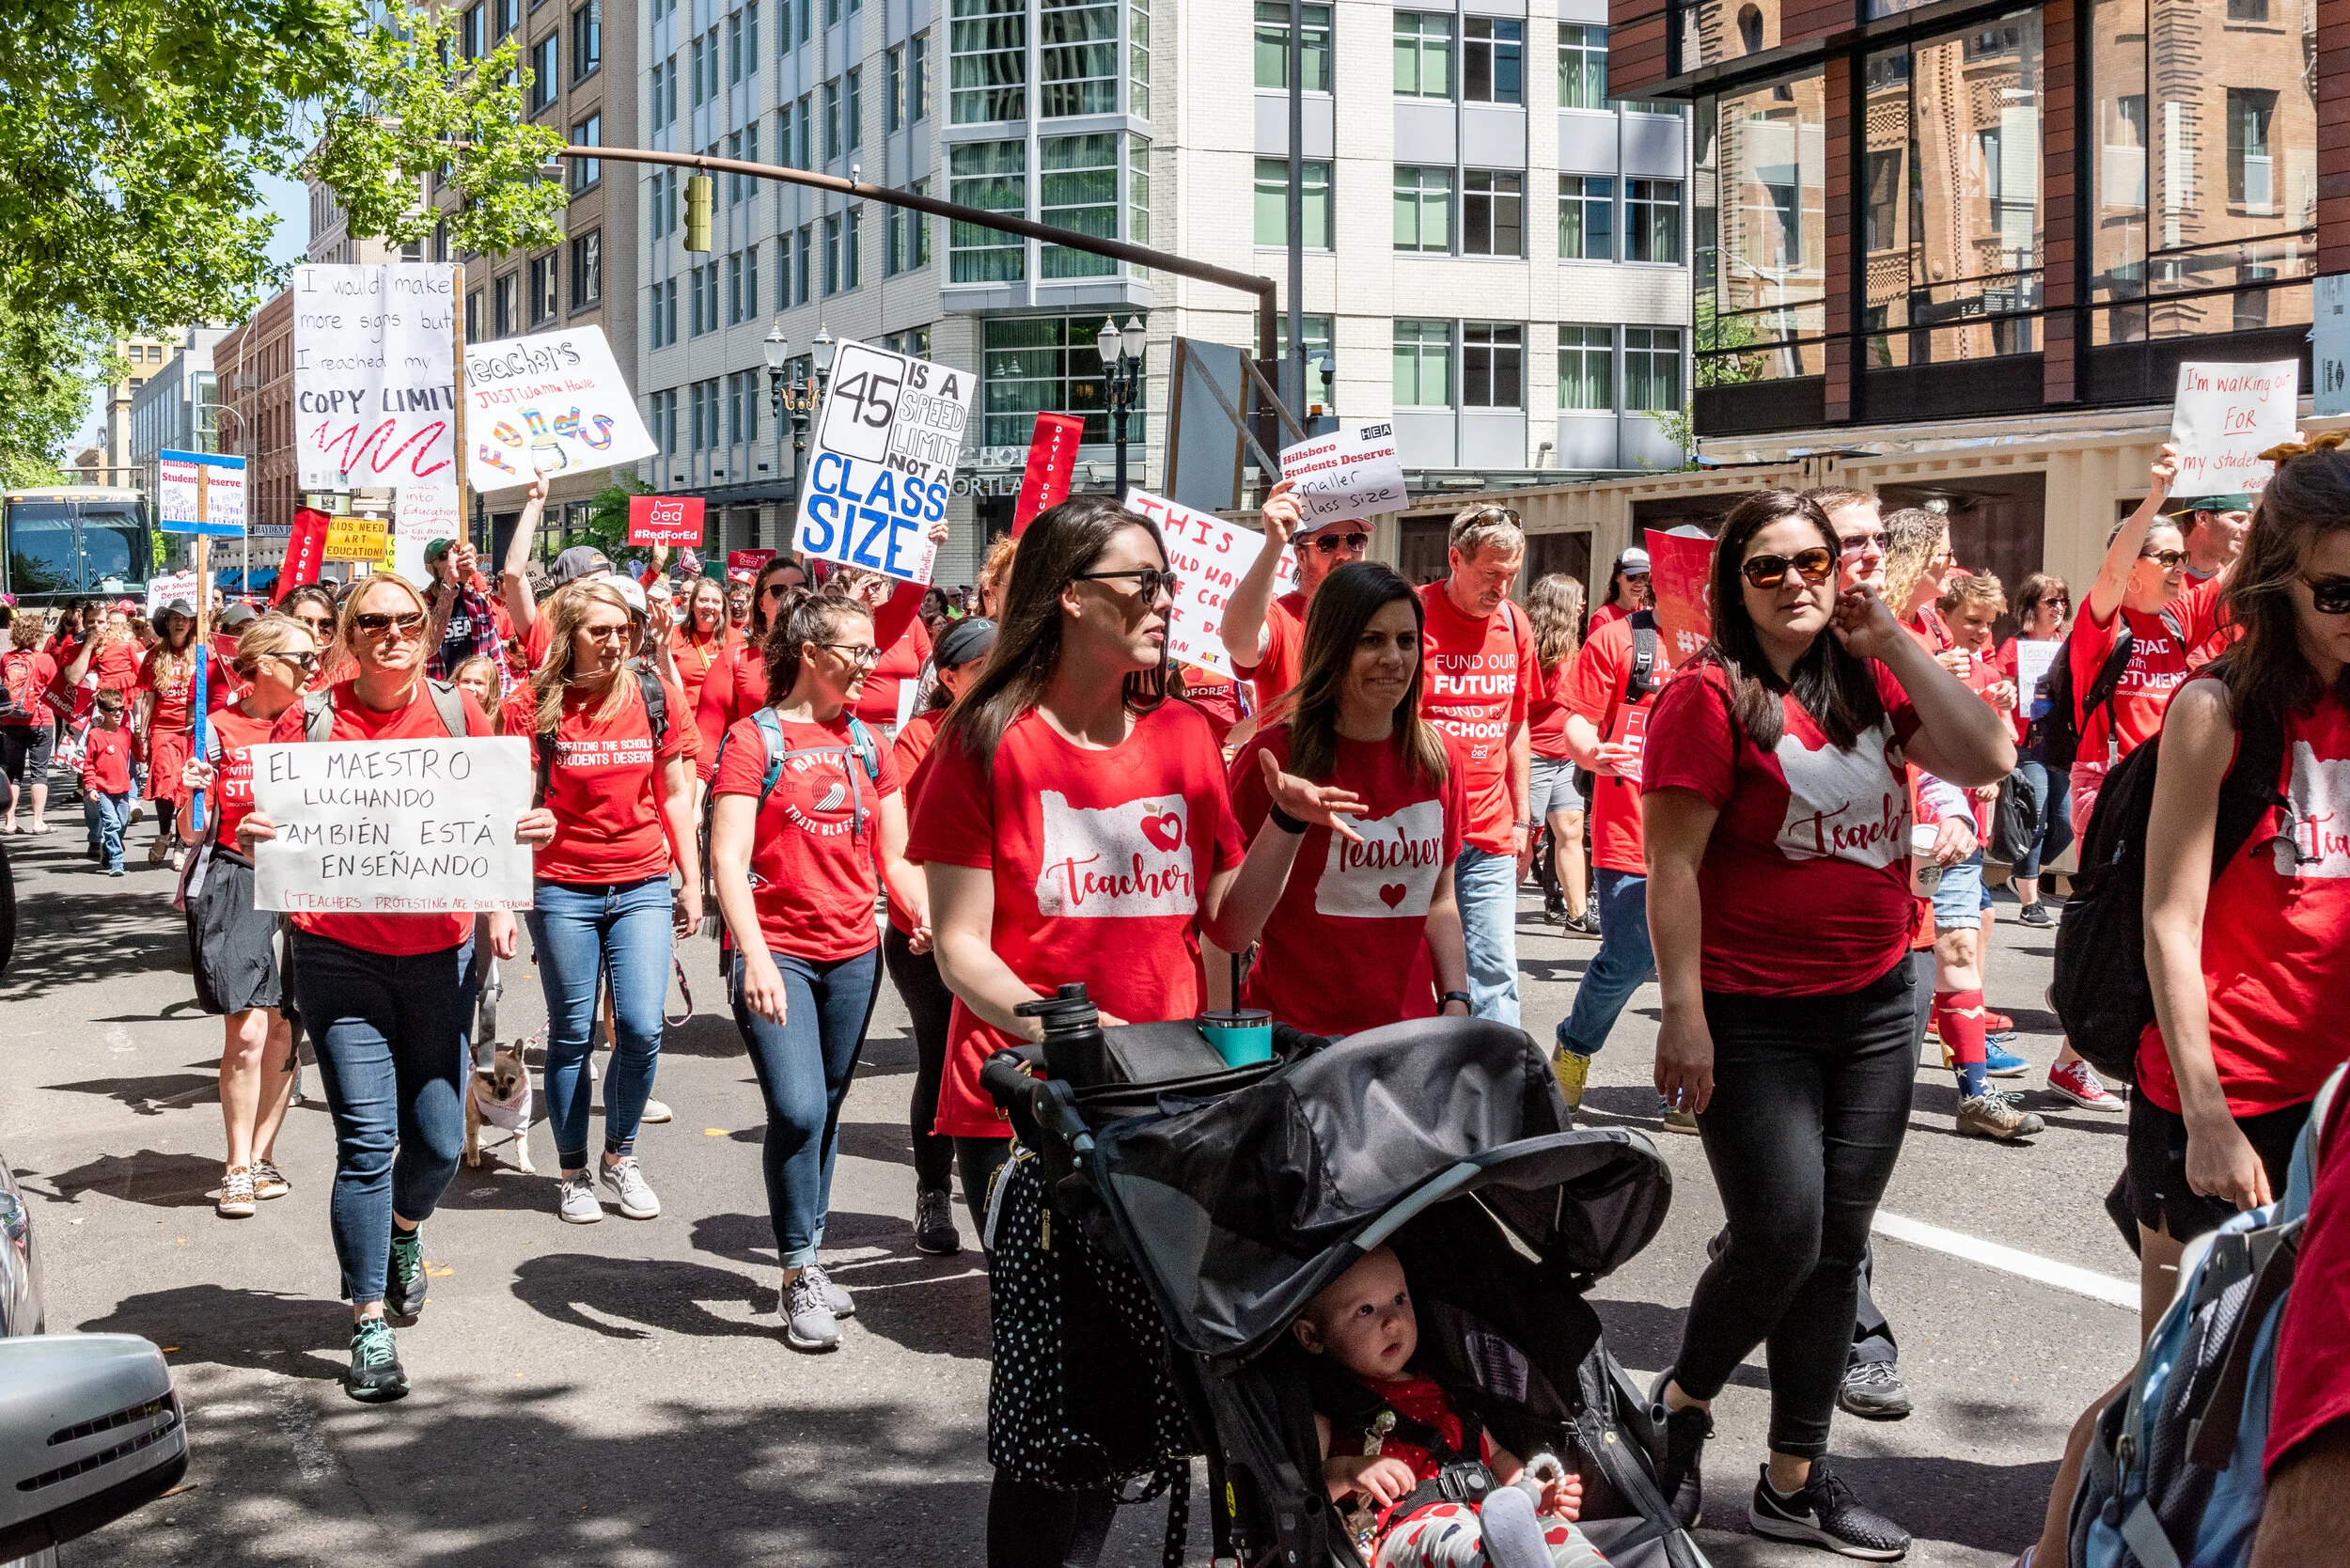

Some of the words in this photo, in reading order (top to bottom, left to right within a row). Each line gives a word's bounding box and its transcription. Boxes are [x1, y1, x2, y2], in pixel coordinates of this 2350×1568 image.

[301, 270, 317, 292] I
[331, 269, 380, 295] would
[395, 270, 450, 294] make
[301, 314, 342, 329] more
[360, 313, 400, 343] signs
[420, 308, 452, 329] but
[296, 349, 310, 369] I
[321, 349, 386, 369] reached
[405, 357, 431, 384] my
[466, 342, 581, 387] Teachers
[475, 388, 517, 409] JUST
[565, 379, 595, 392] Have
[907, 362, 929, 390] IS
[938, 373, 959, 400] A
[2185, 368, 2209, 392] I'm
[2217, 376, 2270, 402] walking
[2274, 373, 2291, 388] out
[299, 388, 366, 415] COPY
[383, 385, 456, 412] LIMIT
[834, 370, 899, 429] 45
[899, 391, 966, 432] SPEED
[1360, 423, 1391, 441] HEA
[2224, 406, 2257, 430] FOR
[890, 424, 961, 466] LIMIT
[980, 447, 1029, 466] HOT
[1047, 425, 1062, 472] DAVID
[1282, 443, 1337, 465] Hillsboro
[162, 472, 198, 484] Student
[886, 452, 931, 479] NOT
[935, 468, 950, 487] A
[1284, 459, 1338, 479] Students
[1340, 447, 1395, 465] Deserve:
[2183, 456, 2207, 480] my
[2213, 449, 2261, 470] studen
[812, 452, 948, 523] CLASS
[950, 477, 1023, 496] ORTLA
[330, 521, 353, 532] KIDS
[358, 523, 384, 533] NEED
[344, 535, 367, 543] ART
[634, 528, 697, 541] #RedForEd
[803, 494, 919, 578] SIZE
[1136, 497, 1233, 554] THIS
[294, 536, 311, 588] CORB
[326, 545, 383, 557] EDUCATION!
[917, 536, 933, 583] #RedForE
[1166, 545, 1199, 572] ULD
[1200, 651, 1219, 664] ART
[1434, 654, 1483, 669] FUND
[1488, 654, 1515, 668] OUR
[161, 688, 188, 697] SCHO
[1183, 685, 1229, 697] DFORED
[1434, 674, 1516, 695] FUTURE
[601, 741, 619, 750] THE
[620, 738, 652, 749] SCHOOLS
[1432, 720, 1509, 738] SCHOOLS
[270, 752, 300, 782] EL
[327, 748, 471, 780] MAESTRO
[613, 750, 653, 763] DESERVE
[304, 788, 434, 808] LUCHANDO
[274, 816, 389, 845] TAMBIÉN
[421, 814, 495, 845] ESTÁ
[785, 804, 817, 834] TRAIL
[822, 807, 870, 836] BLAZES
[1340, 825, 1439, 872] Teacher
[321, 850, 489, 879] ENSEÑANDO
[1046, 853, 1192, 906] Teacher
[284, 889, 362, 909] (TEACHERS
[375, 896, 447, 909] PROTESTING
[452, 897, 467, 909] ARE
[474, 899, 496, 909] STILL
